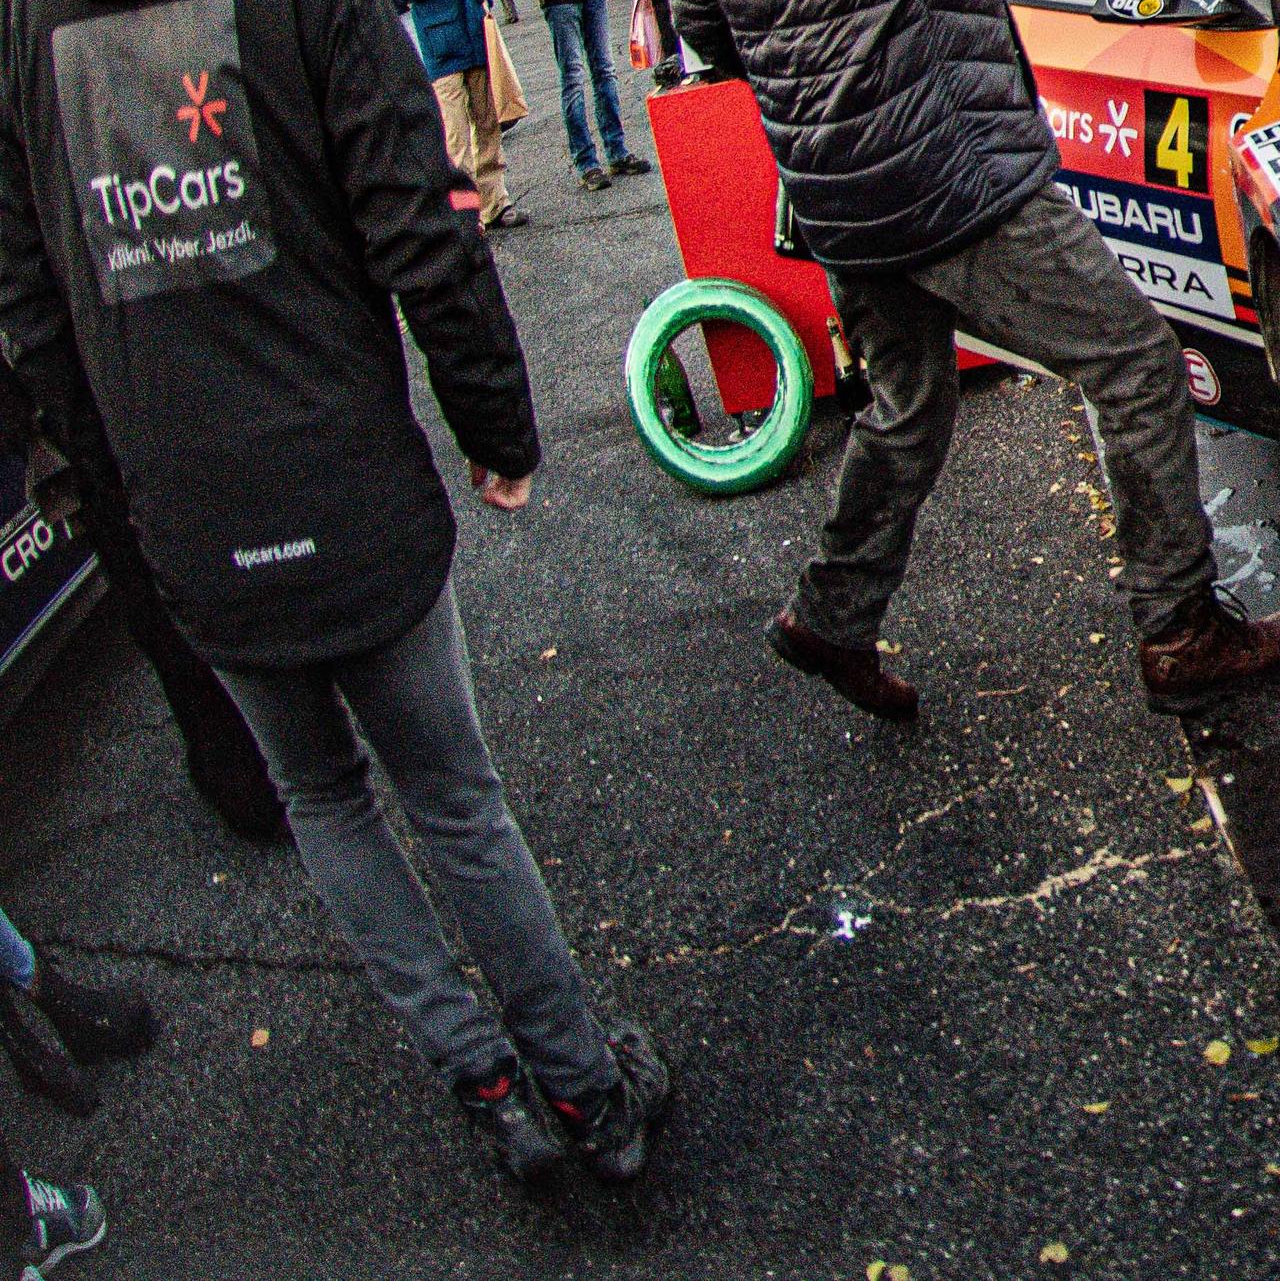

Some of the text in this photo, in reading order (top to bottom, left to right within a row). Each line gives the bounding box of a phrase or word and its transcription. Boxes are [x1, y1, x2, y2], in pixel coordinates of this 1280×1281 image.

[1038, 94, 1094, 144] ars
[1155, 97, 1194, 189] 4
[89, 159, 245, 231] TipCars
